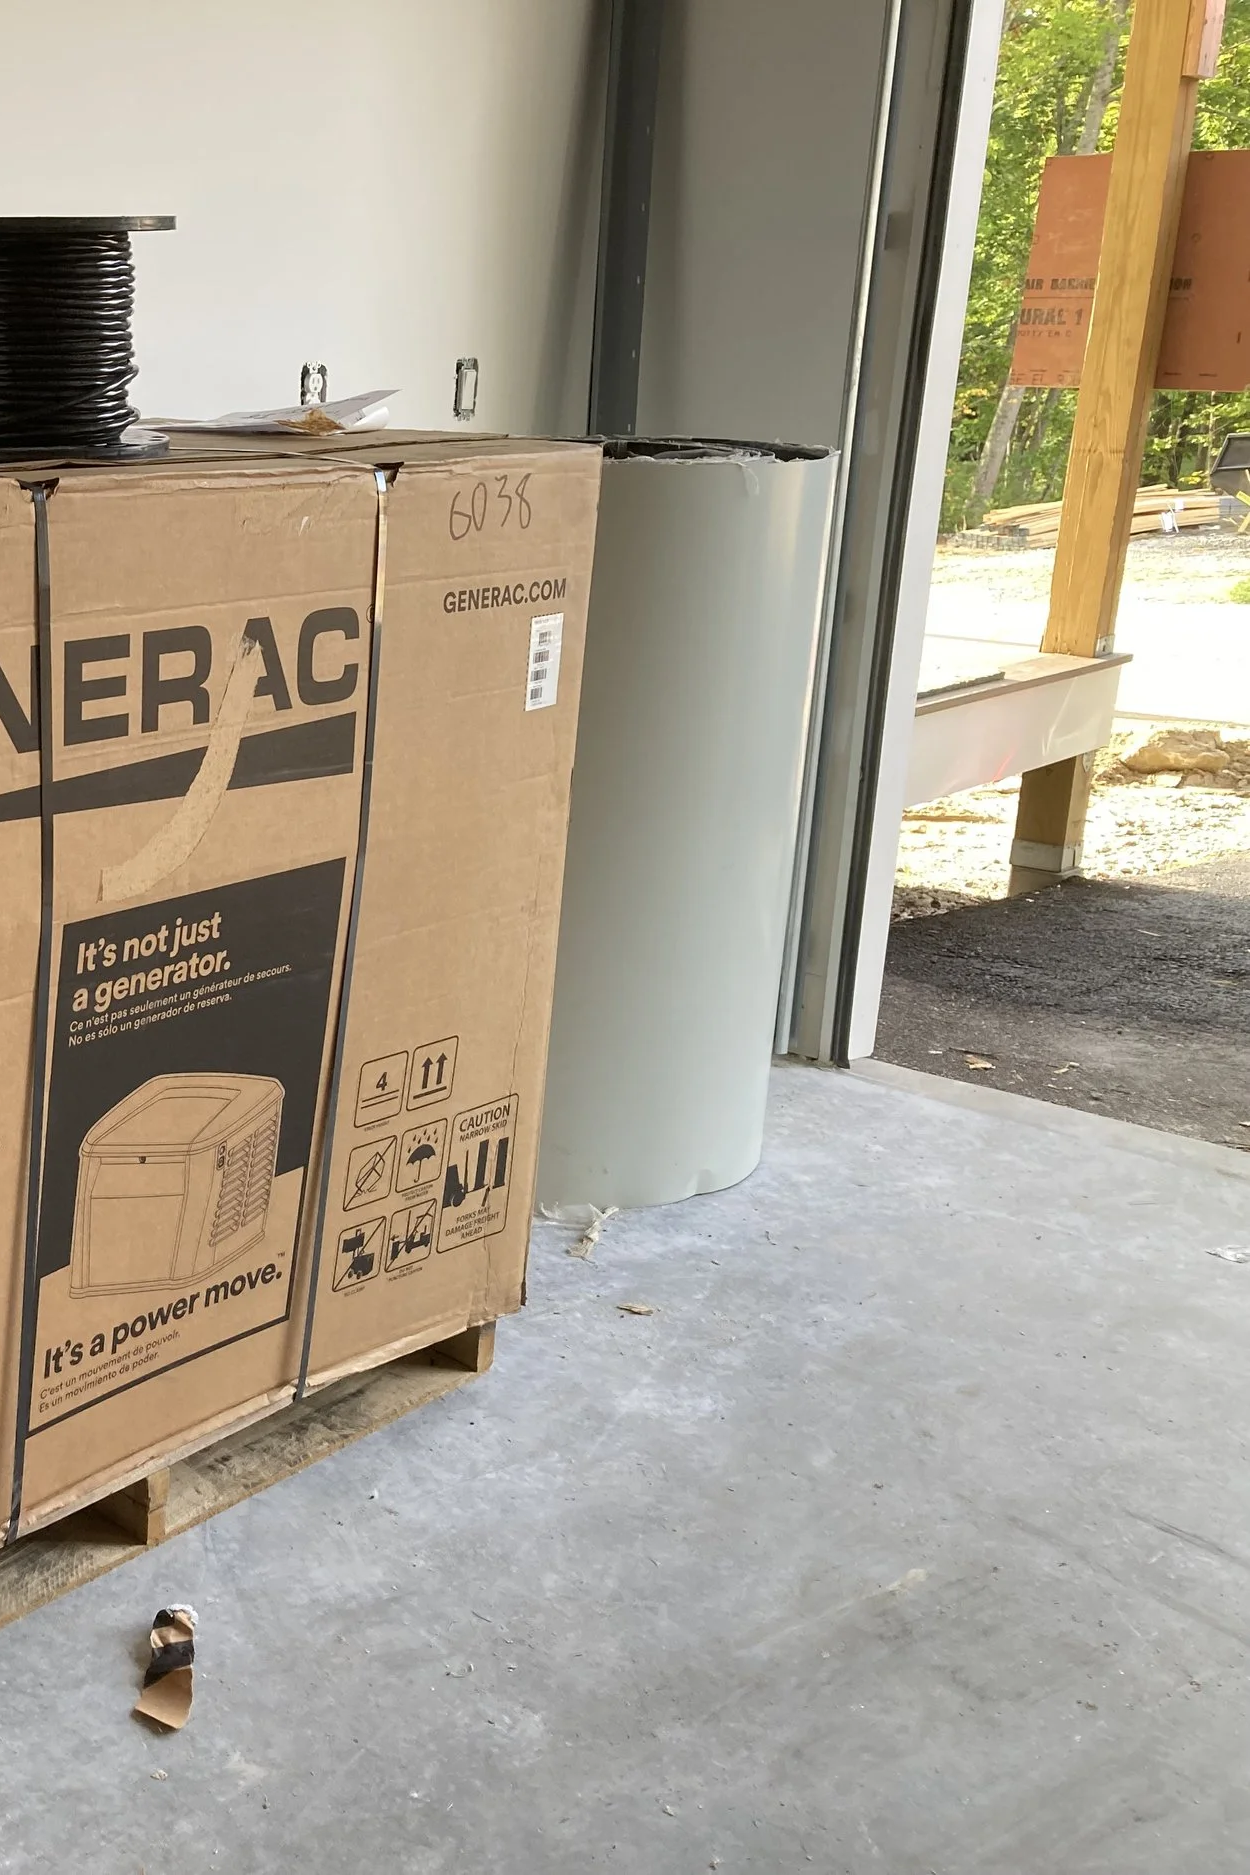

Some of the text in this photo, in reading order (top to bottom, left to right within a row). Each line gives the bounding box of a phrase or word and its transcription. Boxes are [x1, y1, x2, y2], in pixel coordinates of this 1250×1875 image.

[1075, 307, 1083, 326] 1
[449, 473, 533, 541] 6038
[443, 576, 567, 615] GENERAC.COM
[76, 911, 222, 975] It's not just
[69, 1020, 85, 1033] Ce
[110, 1009, 128, 1024] pas
[129, 994, 179, 1016] seulement
[179, 990, 191, 1002] un
[192, 976, 242, 1002] générateur
[243, 970, 255, 984] de
[256, 963, 294, 981] secours.
[72, 949, 232, 1014] a generator.
[68, 993, 233, 1048] No es sólo un generador de reserva.
[375, 1071, 388, 1091] 4
[459, 1102, 511, 1133] CAUTION
[459, 1119, 508, 1143] NARROW SKID
[445, 1222, 473, 1237] DAMAGE
[456, 1211, 478, 1225] FORKS
[460, 1226, 483, 1240] AHEAD
[43, 1339, 83, 1379] It's
[88, 1331, 106, 1357] a
[110, 1290, 201, 1355] power
[38, 1382, 64, 1401] C'est
[64, 1377, 77, 1391] un
[78, 1355, 132, 1385] mouvement
[132, 1344, 144, 1358] de
[38, 1399, 50, 1414] Es
[50, 1394, 63, 1408] un
[64, 1369, 118, 1401] movimiento
[118, 1361, 131, 1375] de
